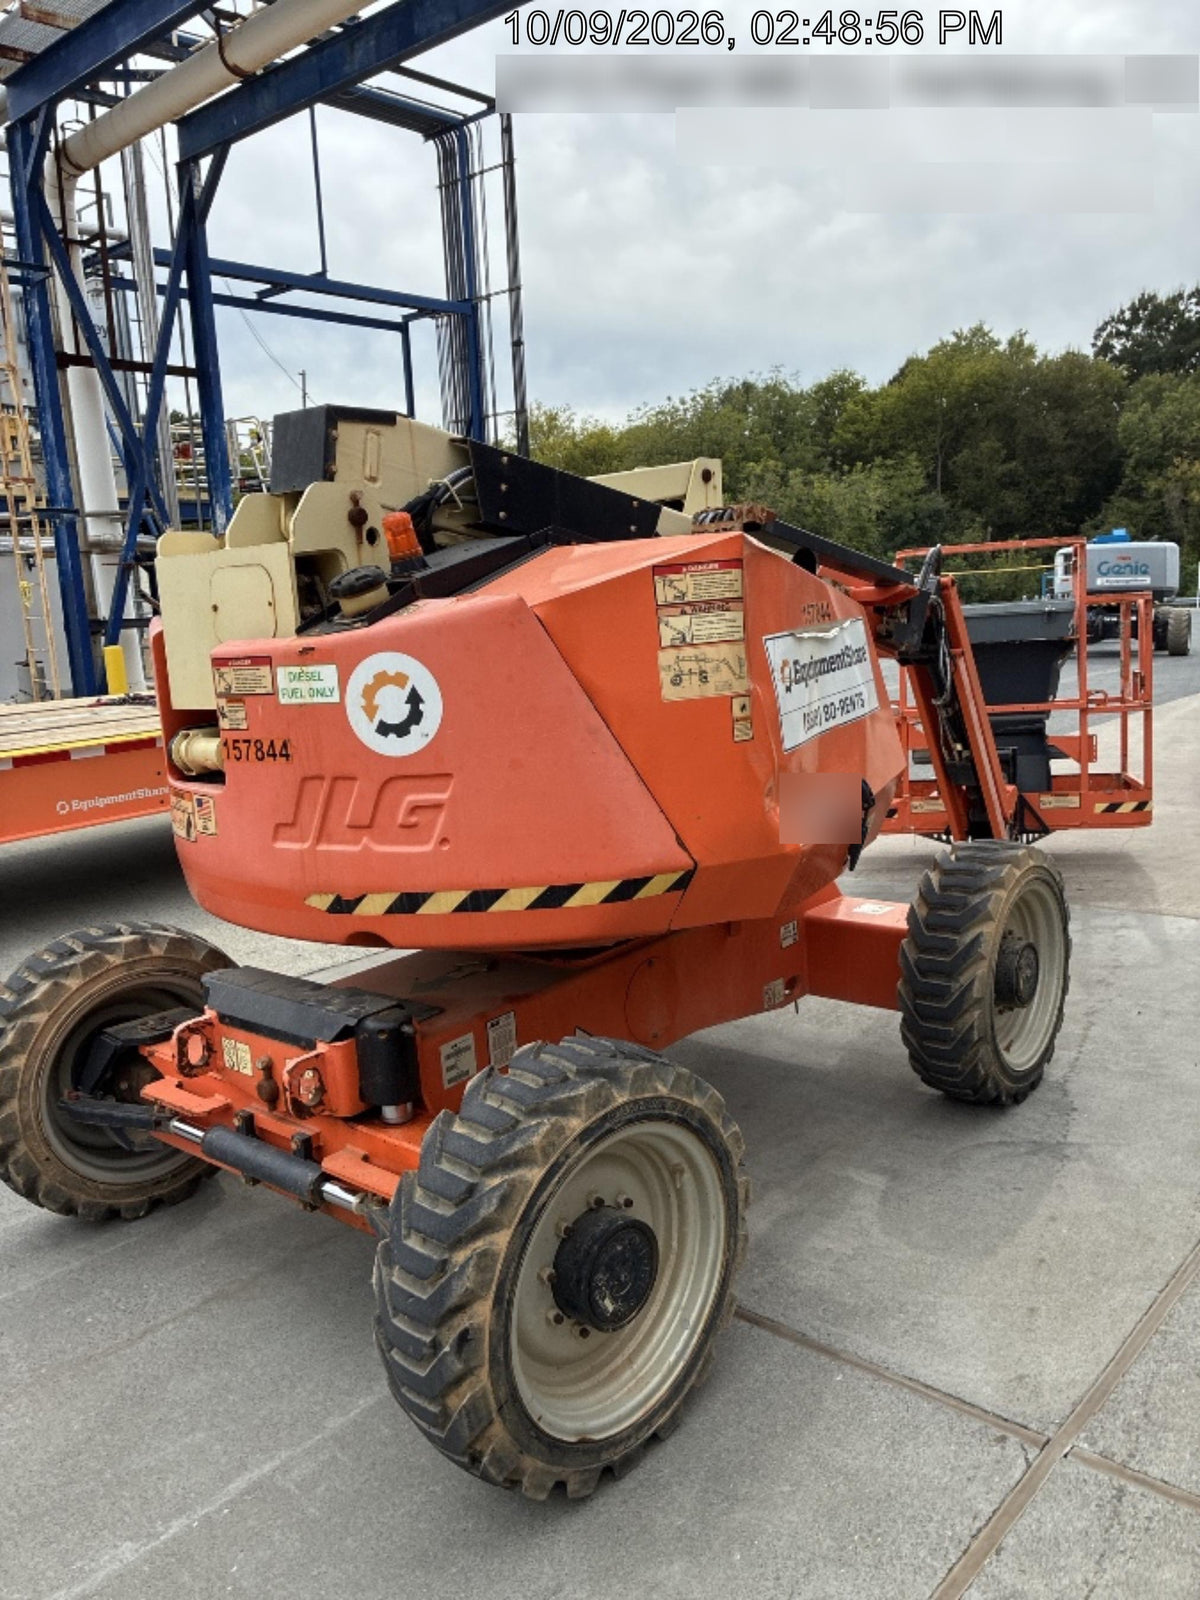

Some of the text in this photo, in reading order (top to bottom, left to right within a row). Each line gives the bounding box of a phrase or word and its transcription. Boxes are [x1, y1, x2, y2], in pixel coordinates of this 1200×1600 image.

[1097, 560, 1150, 577] Genie
[287, 670, 324, 682] DIESEL
[281, 687, 335, 700] FUEL ONLY
[223, 739, 291, 762] 157844
